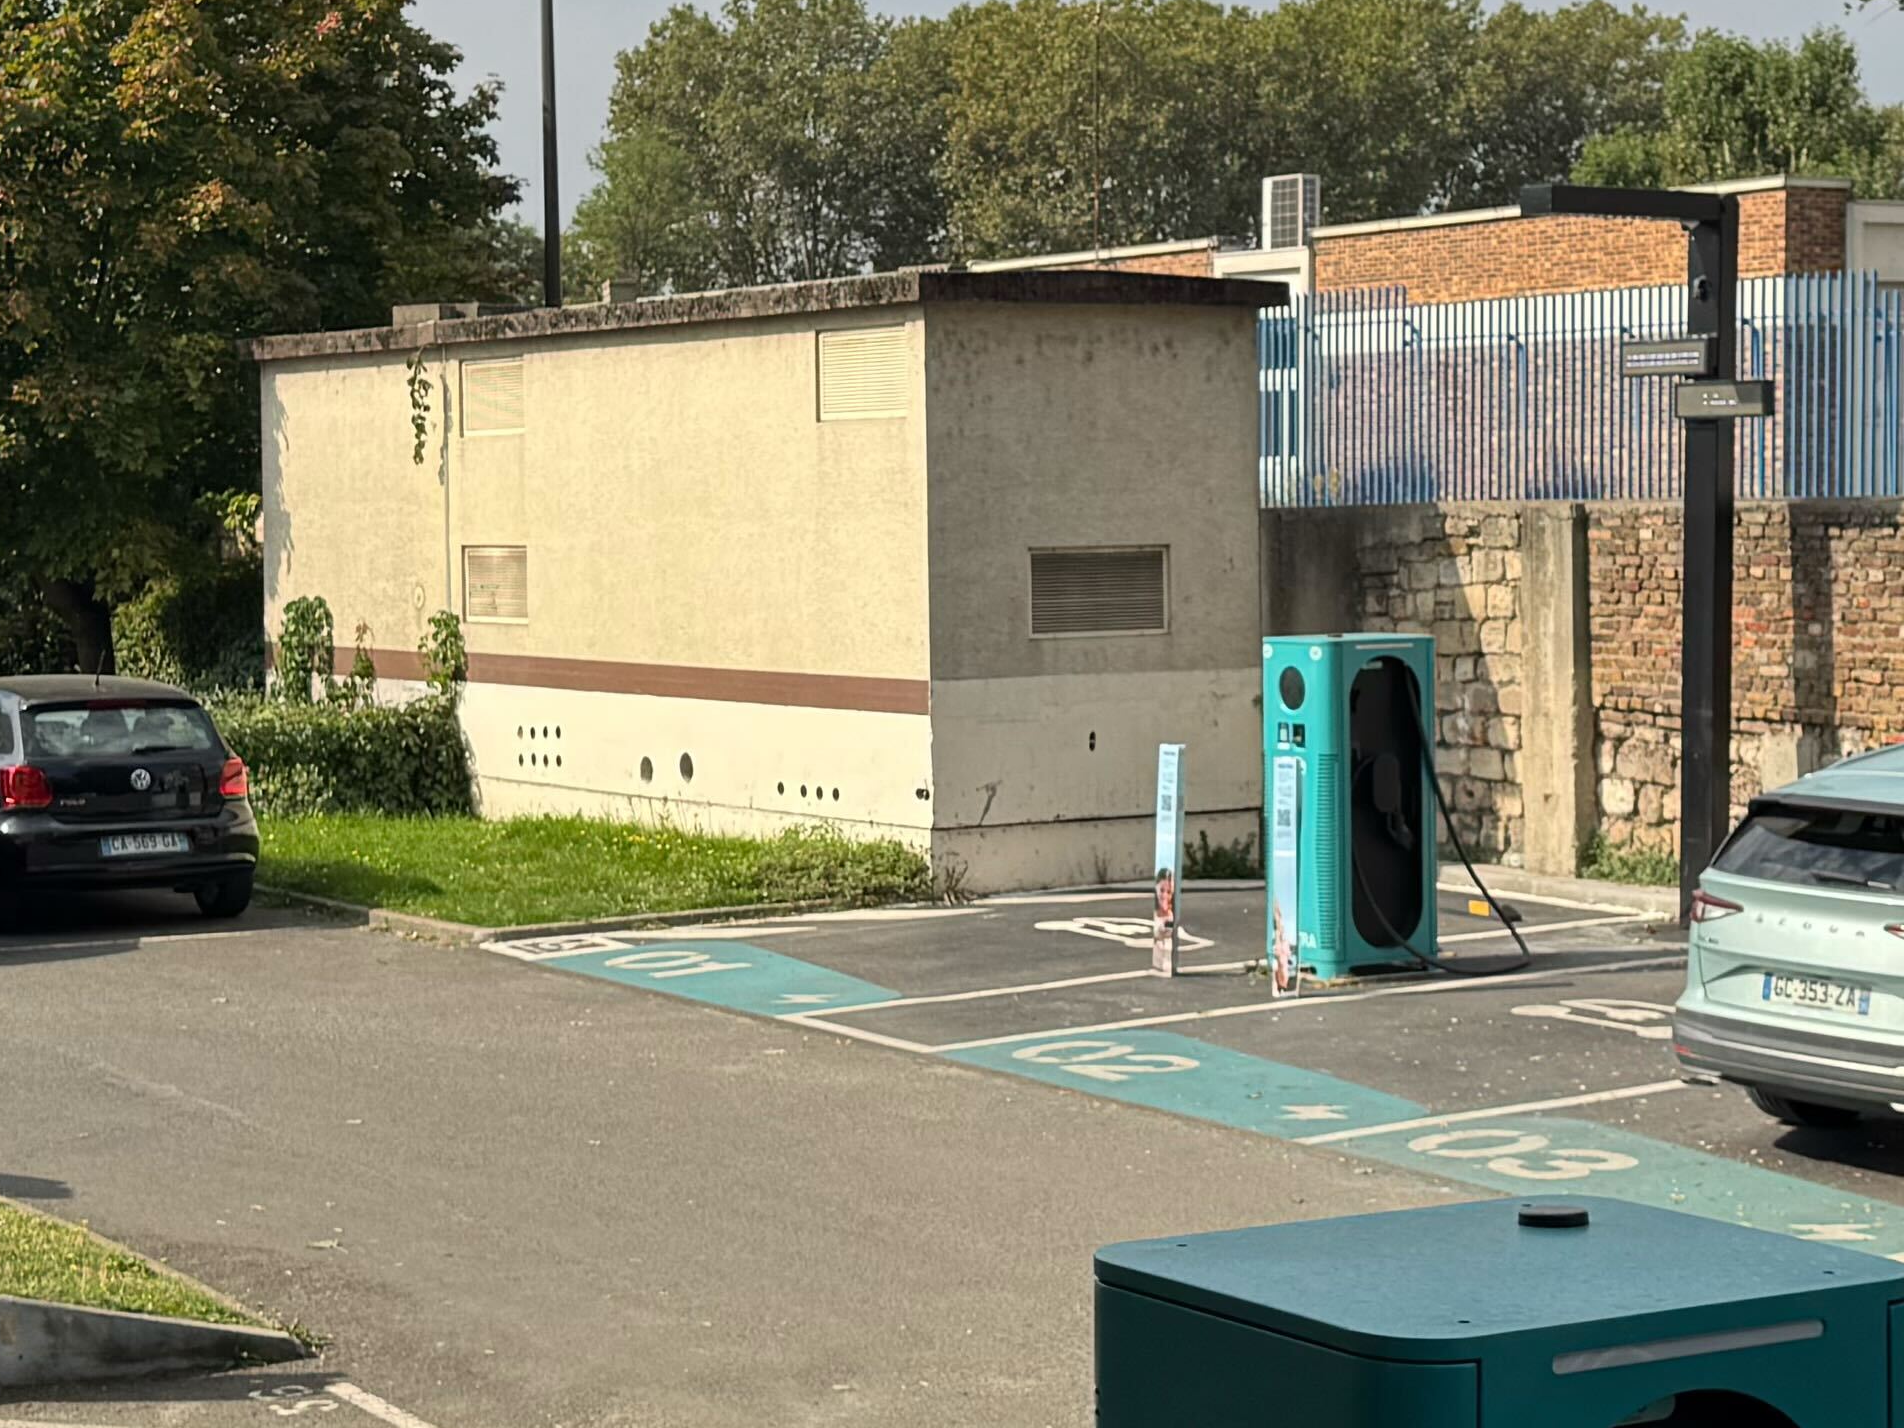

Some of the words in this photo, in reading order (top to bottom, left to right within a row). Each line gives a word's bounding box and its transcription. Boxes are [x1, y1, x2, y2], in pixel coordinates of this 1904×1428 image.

[604, 950, 752, 979] 01
[1773, 976, 1855, 1007] GC-353-ZA
[1011, 1040, 1200, 1082] 02
[1407, 1128, 1639, 1180] 03
